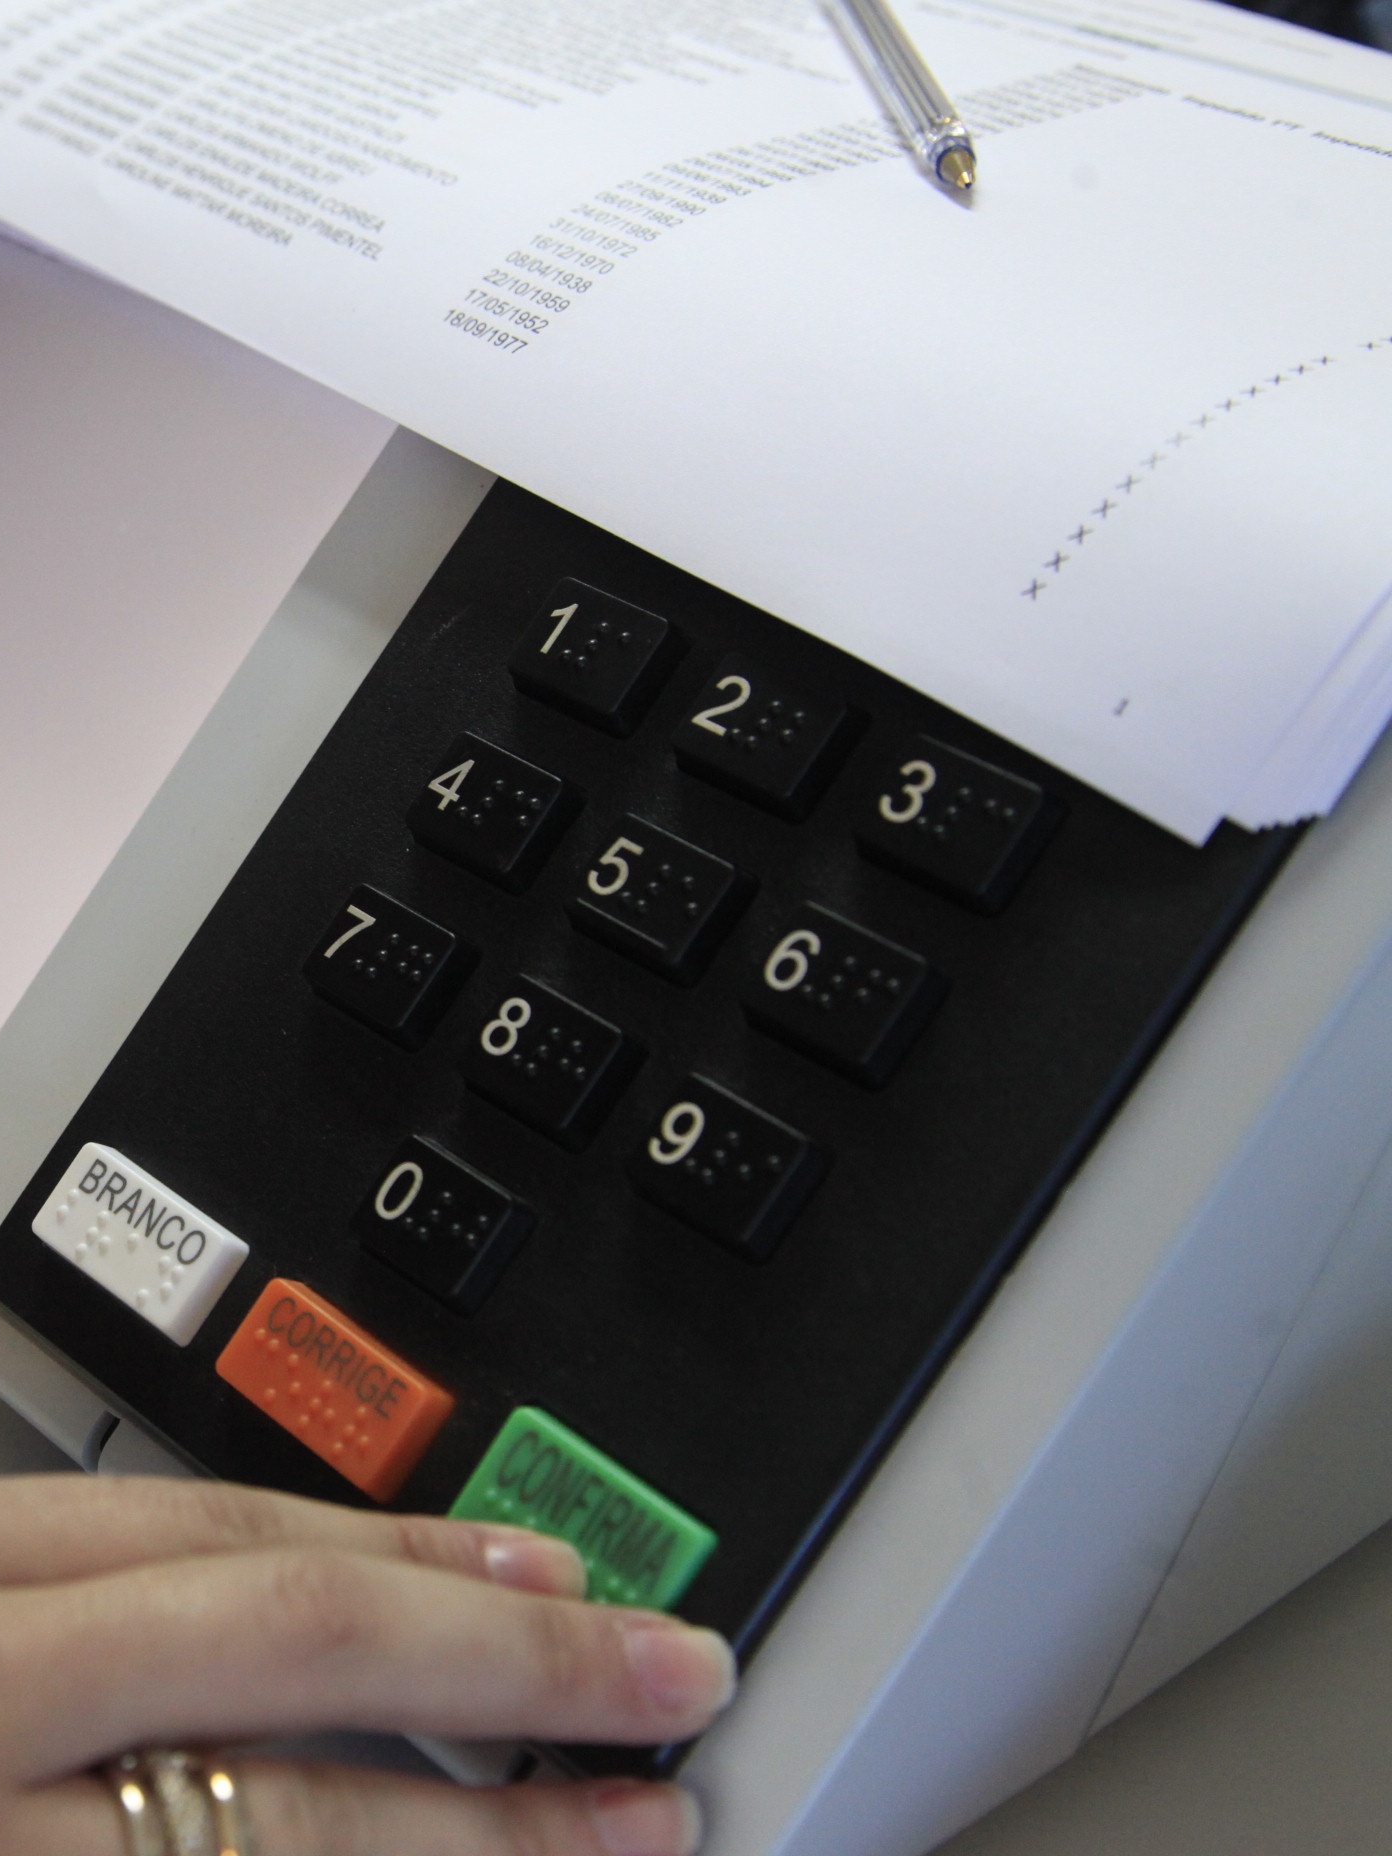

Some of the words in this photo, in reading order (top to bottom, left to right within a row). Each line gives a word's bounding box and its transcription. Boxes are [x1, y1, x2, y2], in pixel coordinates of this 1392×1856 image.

[225, 206, 294, 248] MOREIRA
[248, 189, 312, 228] SANTOS
[308, 217, 384, 262] PIMENTEL
[319, 194, 387, 236] CORREA
[548, 216, 640, 259] 31/10/1972
[570, 202, 662, 243] 24/07/1985
[504, 250, 593, 295] 08/04/1938
[529, 232, 616, 277] 16/12/1970
[463, 287, 550, 335] 17/05/1952
[482, 268, 571, 314] 22/10/1959
[442, 308, 529, 355] 18/09/1977
[539, 602, 579, 655] 1
[690, 674, 752, 737] 2
[427, 758, 476, 811] 4
[879, 759, 937, 823] 3
[586, 836, 644, 896] 5
[323, 903, 377, 959] 7
[764, 929, 821, 991] 6
[480, 996, 532, 1057] 8
[648, 1101, 705, 1165] 9
[78, 1158, 207, 1266] BRANCO
[374, 1161, 424, 1221] 0
[267, 1297, 409, 1420] CORRIGE
[497, 1430, 678, 1596] CONFIRMA
